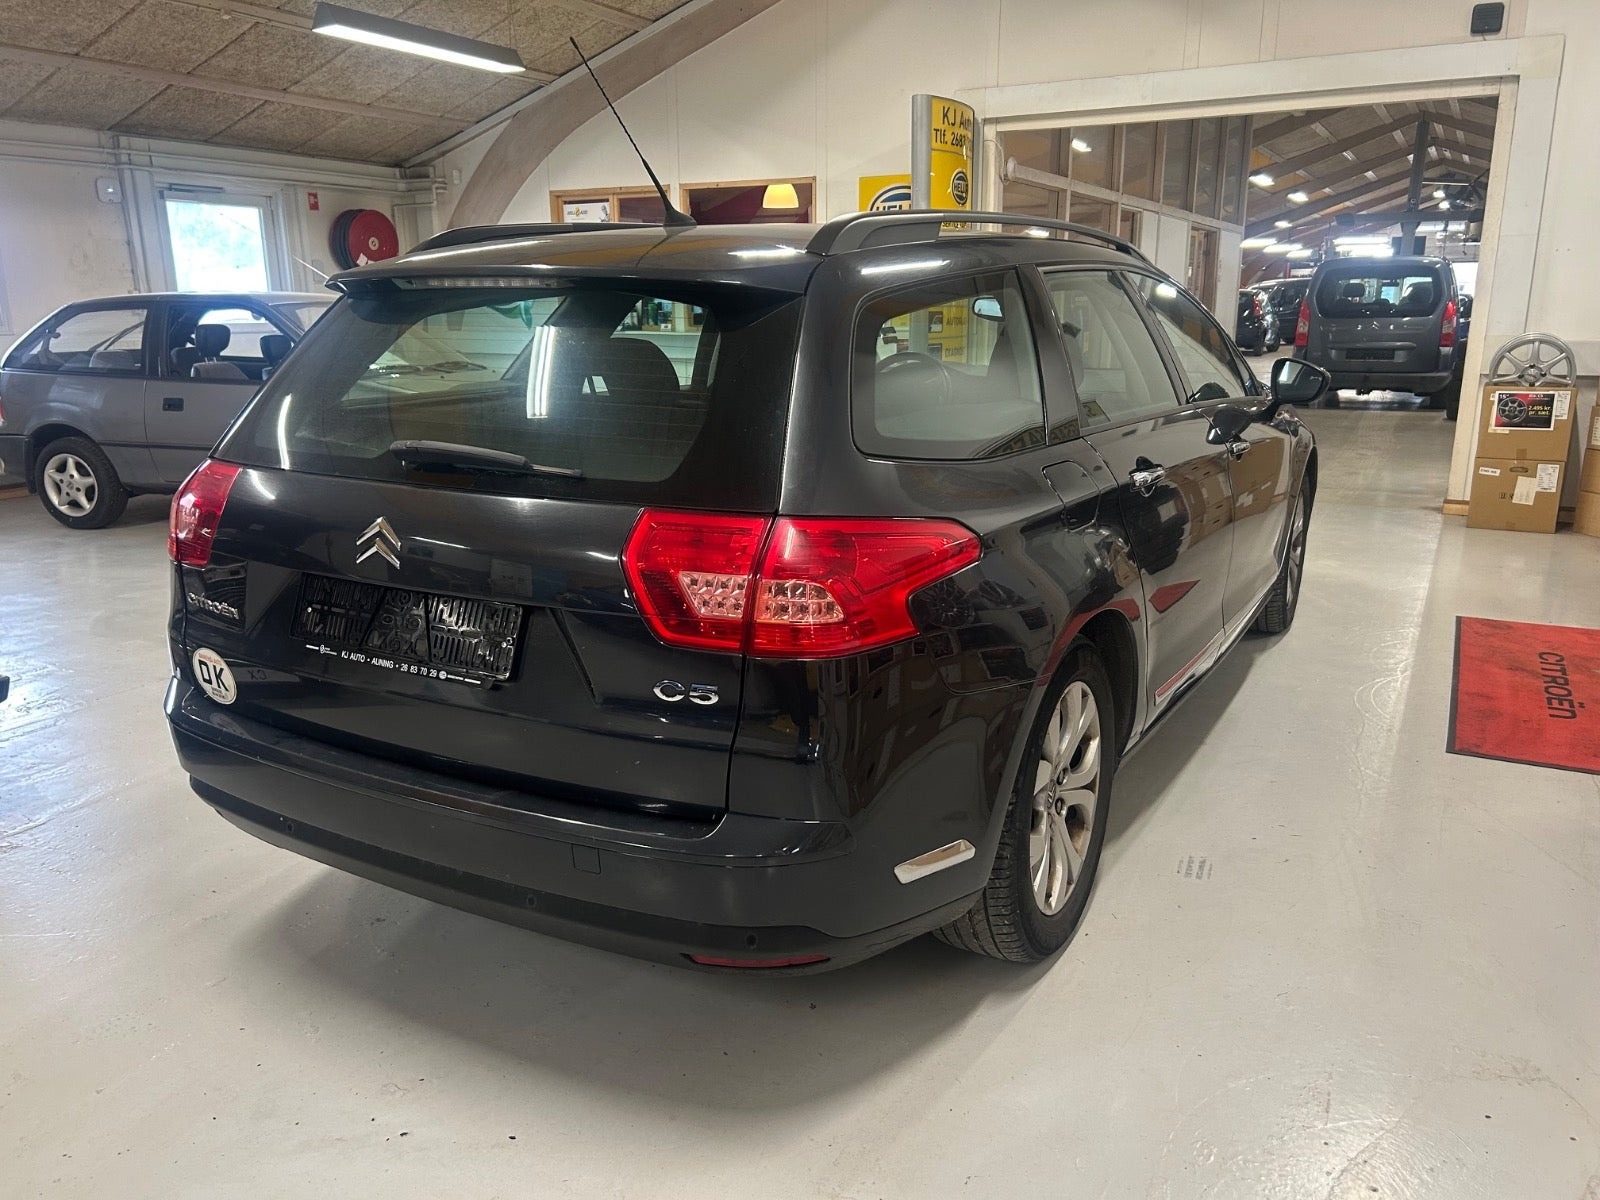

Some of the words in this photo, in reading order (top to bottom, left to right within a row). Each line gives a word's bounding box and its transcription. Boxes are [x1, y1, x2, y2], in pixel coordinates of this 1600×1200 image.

[942, 105, 957, 127] KJ
[933, 128, 948, 145] Tlf.
[198, 659, 229, 692] DK
[341, 650, 349, 659] KJ
[350, 652, 365, 662] AUTO
[400, 663, 408, 672] 26
[410, 665, 418, 674] 83
[420, 667, 427, 675] 70
[429, 669, 437, 677] 29
[653, 680, 719, 705] C5
[1538, 651, 1586, 719] CITROËN
